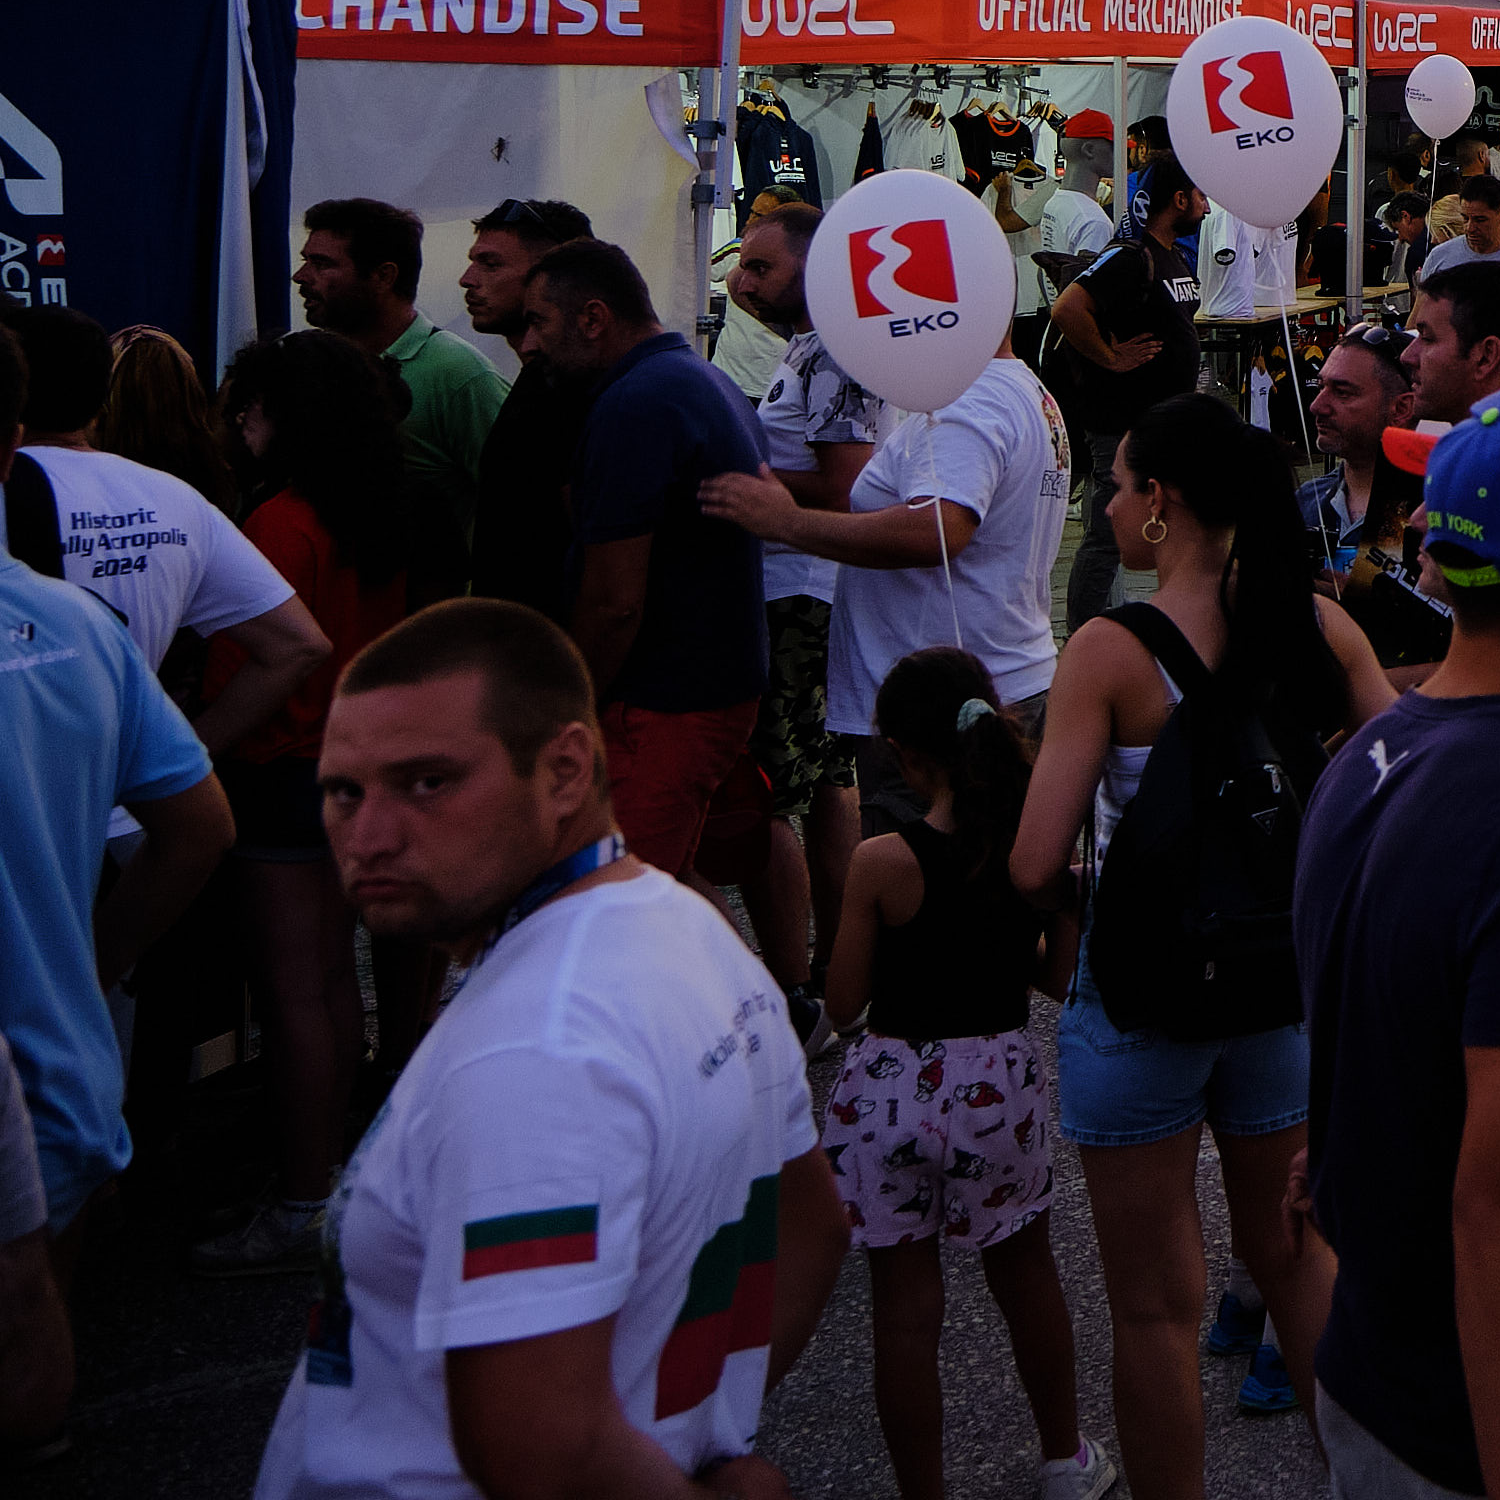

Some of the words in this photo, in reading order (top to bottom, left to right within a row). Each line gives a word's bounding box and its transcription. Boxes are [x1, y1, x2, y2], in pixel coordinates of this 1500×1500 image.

[1374, 10, 1438, 53] WRC
[1235, 125, 1295, 151] EKO
[889, 309, 960, 339] EKO
[70, 507, 159, 530] Historic
[1446, 512, 1484, 541] YORK
[97, 527, 189, 552] Acropolis
[91, 554, 149, 579] 2024
